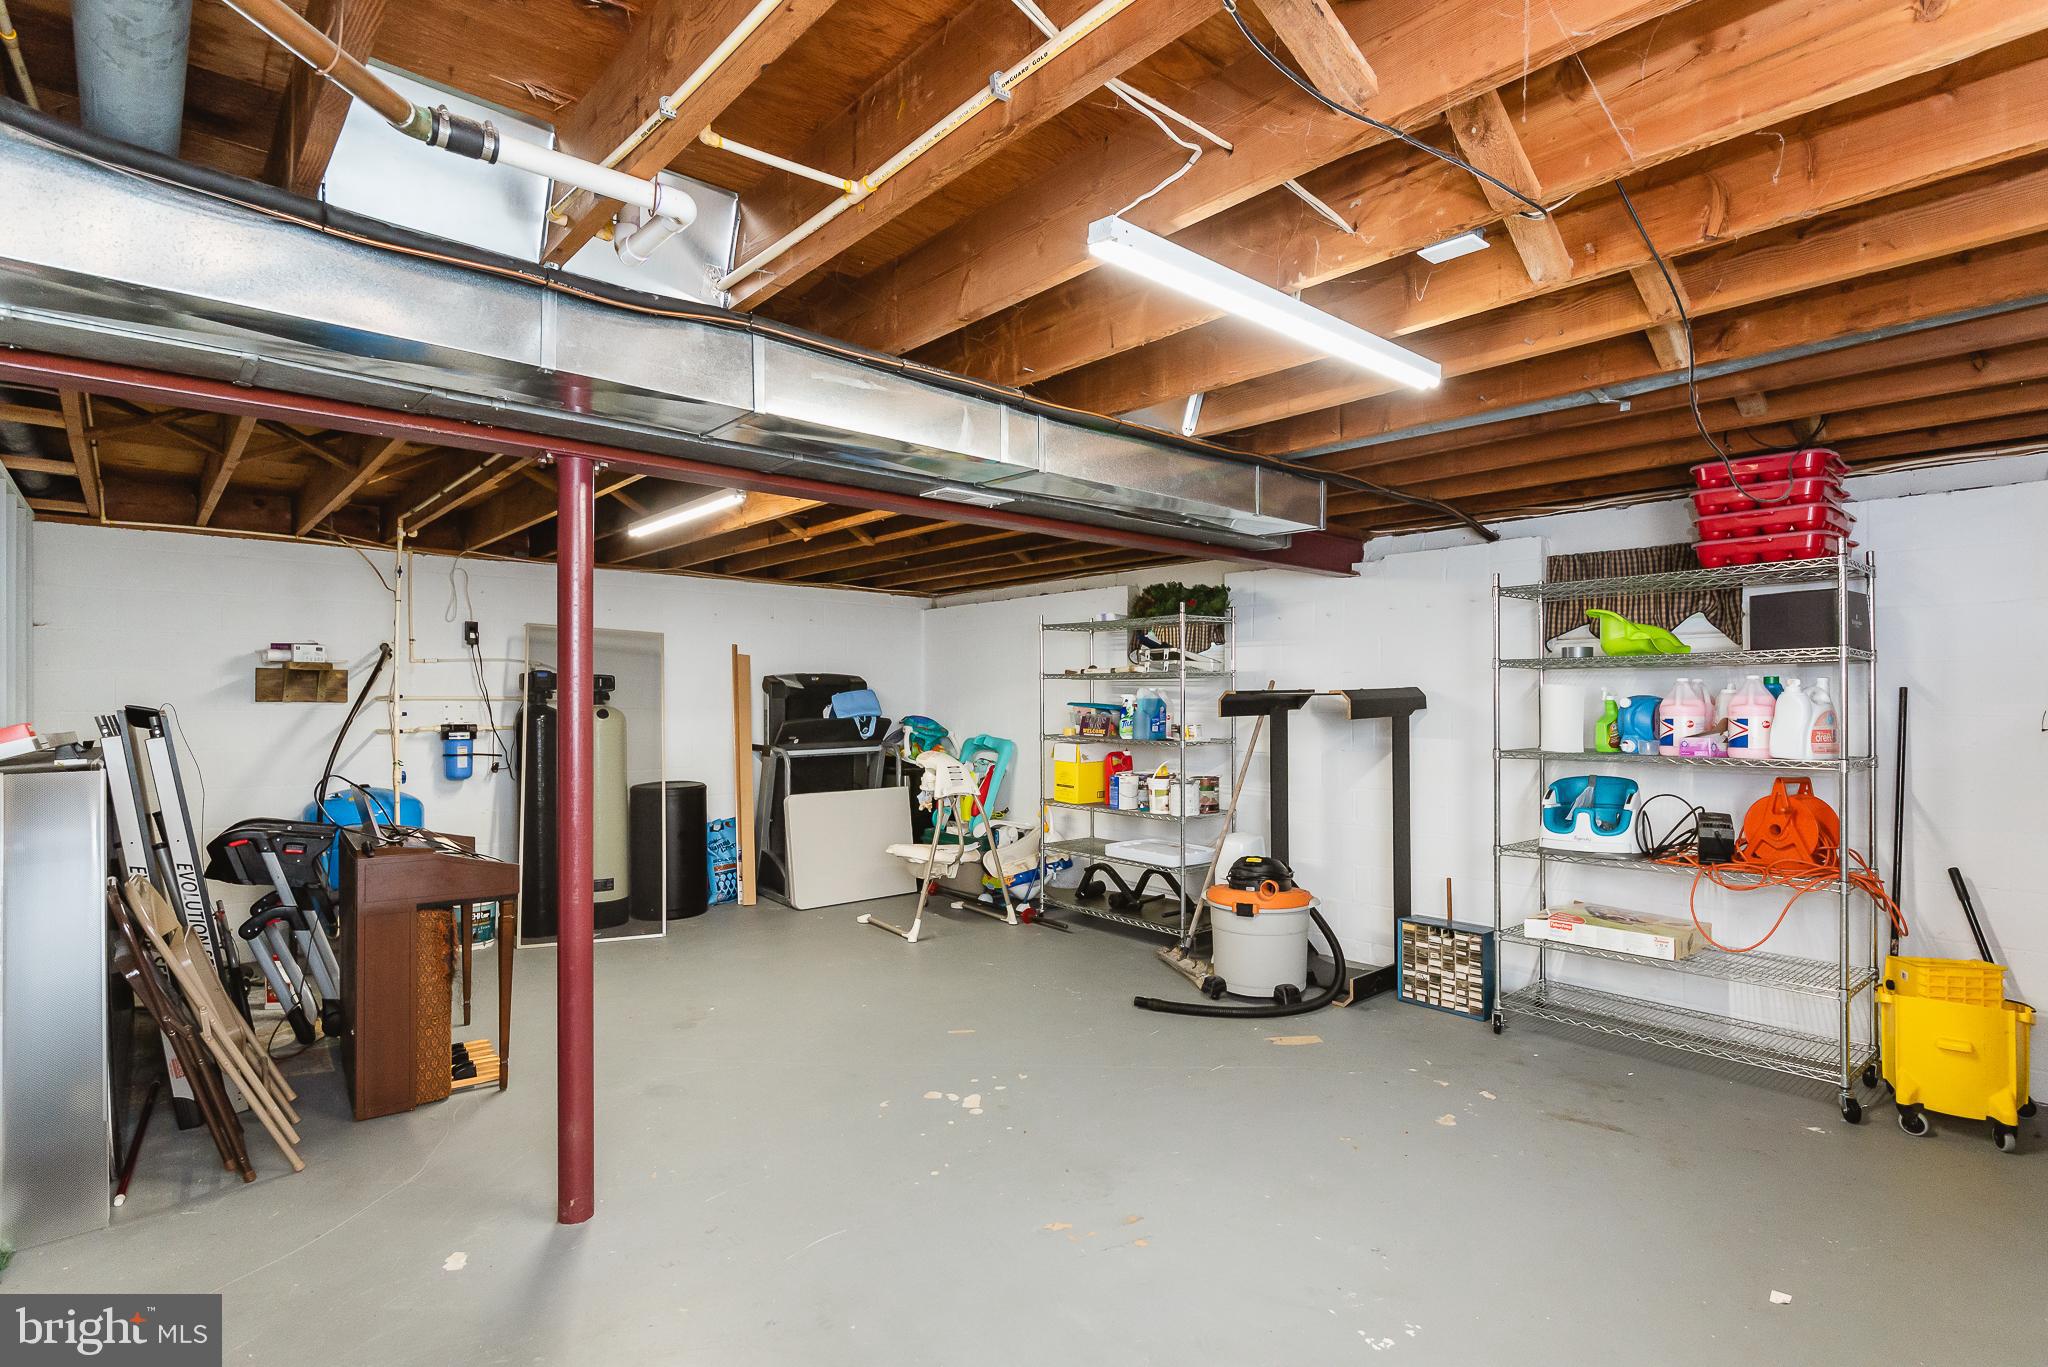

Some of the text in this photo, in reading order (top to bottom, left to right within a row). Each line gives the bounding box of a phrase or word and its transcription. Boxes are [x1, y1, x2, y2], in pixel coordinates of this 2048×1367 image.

[1001, 51, 1049, 88] OWGUARD GOLD
[1815, 731, 1833, 743] dreft
